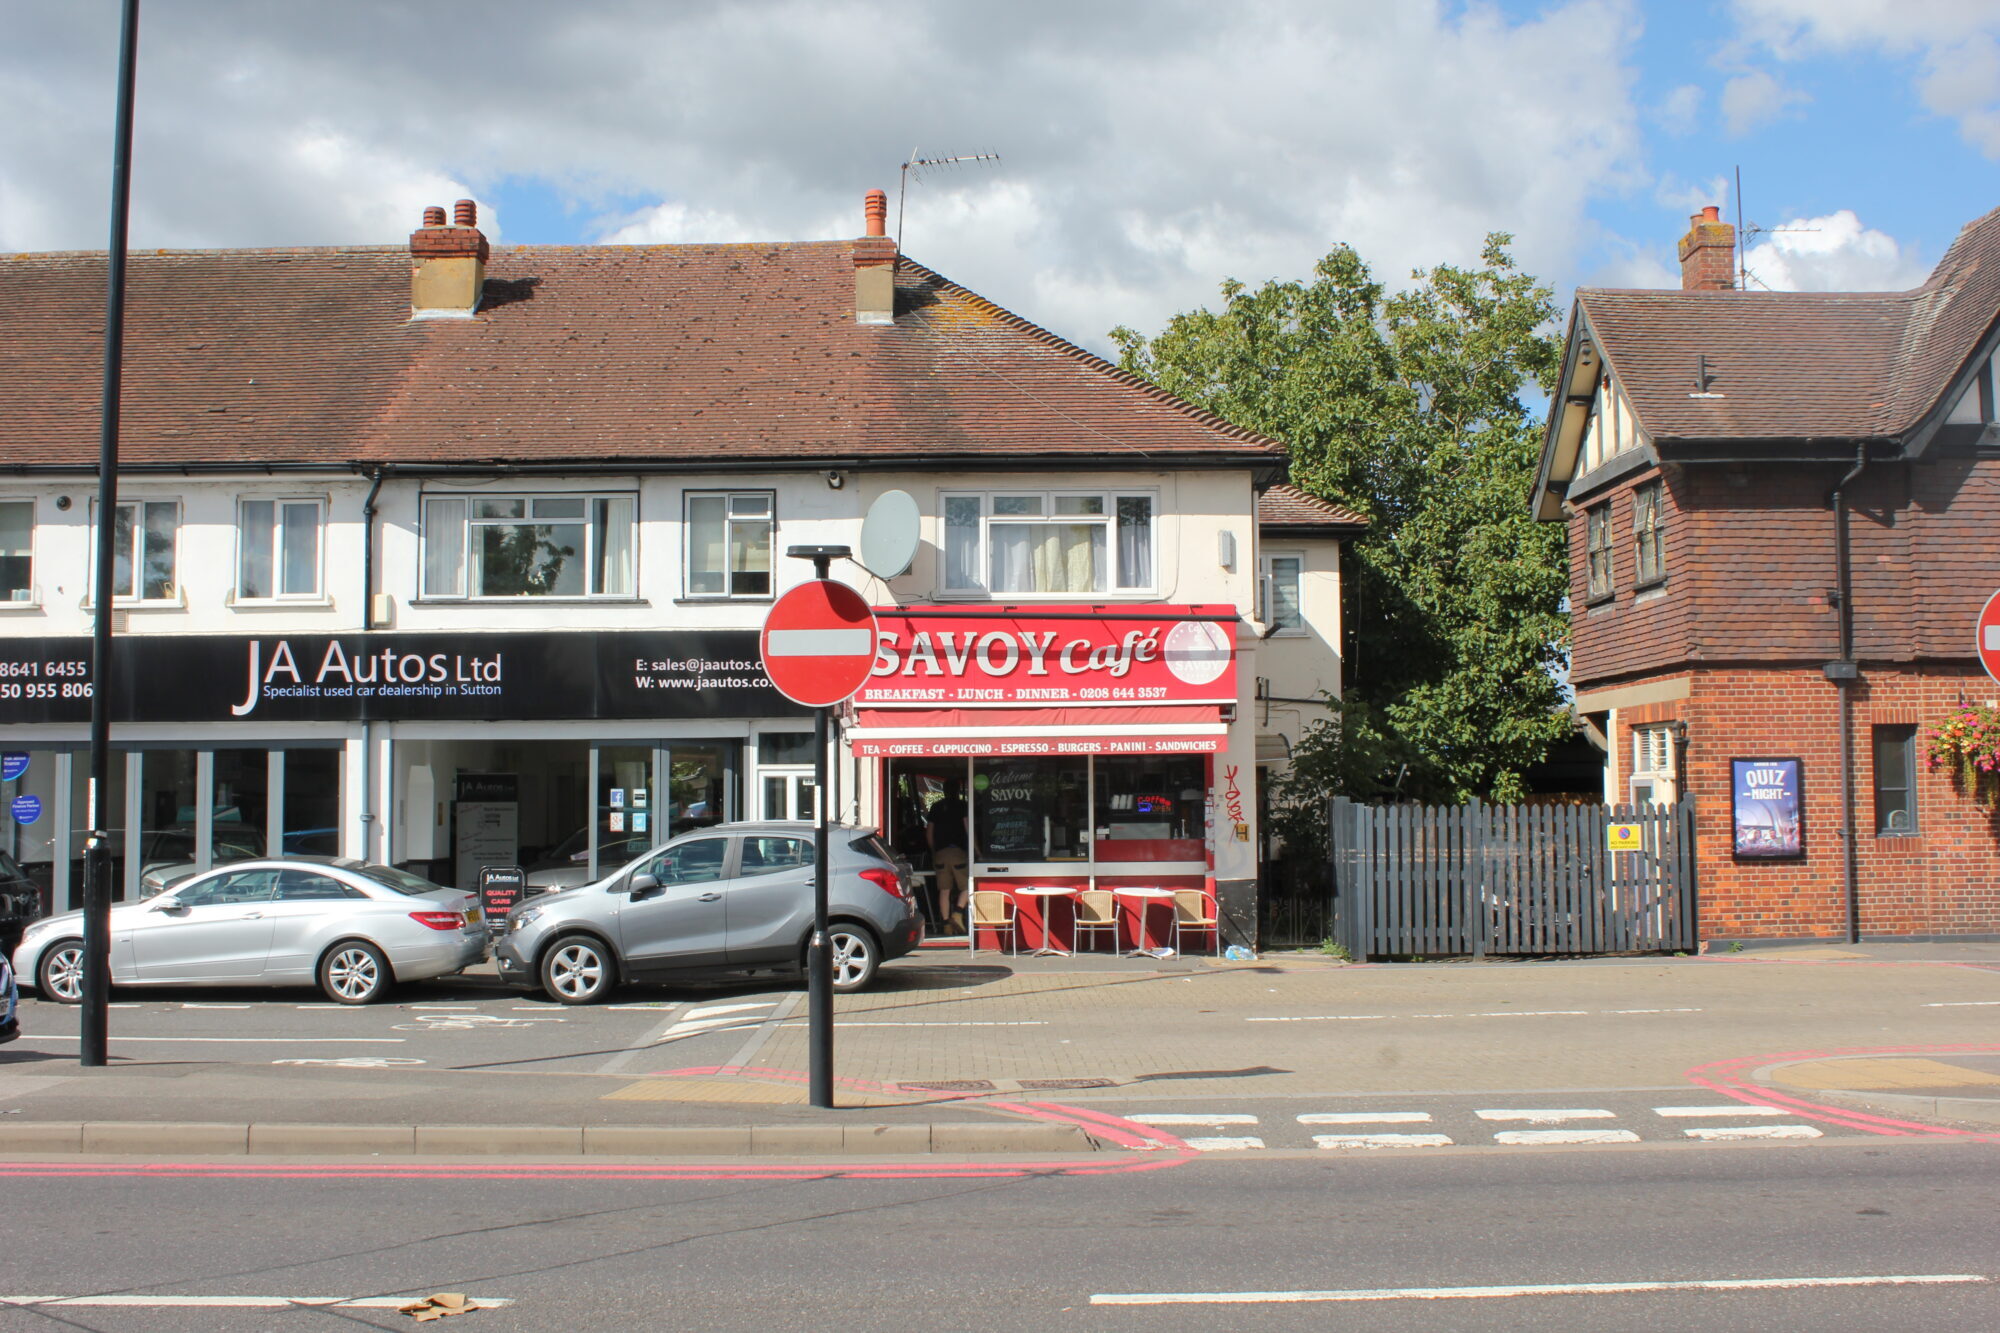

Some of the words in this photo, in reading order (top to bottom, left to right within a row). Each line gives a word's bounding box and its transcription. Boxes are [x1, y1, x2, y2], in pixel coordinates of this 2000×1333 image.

[871, 631, 1057, 677] SAVOY
[1060, 627, 1161, 678] Café
[0, 661, 38, 677] 8641
[45, 661, 87, 677] 6455
[636, 658, 648, 671] E:
[231, 640, 302, 716] JA
[315, 639, 449, 683] Autos
[456, 653, 502, 682] Ltd
[635, 676, 655, 689] W:
[0, 683, 22, 698] 50
[25, 683, 57, 698] 955
[61, 683, 94, 698] 806
[263, 684, 321, 699] Specialist
[323, 684, 353, 697] used
[356, 686, 375, 697] car
[378, 683, 442, 699] dealership
[445, 684, 457, 696] in
[460, 683, 502, 696] Sutton
[864, 688, 945, 700] BREAKFAST
[957, 688, 1004, 699] LUNCH
[1015, 687, 1070, 699] DINNER
[1079, 687, 1110, 699] 0208
[1112, 687, 1135, 698] 644
[1137, 686, 1168, 698] 3537
[862, 744, 880, 755] TEA
[889, 744, 923, 754] COFFEE
[932, 743, 992, 753] CAPPUCCINO
[1001, 742, 1049, 753] ESPRESSO
[1057, 743, 1102, 753] BURGERS
[1110, 741, 1146, 752] PANINI
[1154, 740, 1217, 751] SANDWICHES
[1745, 769, 1786, 788] QUIZ
[990, 788, 1033, 801] SAVOY
[1751, 788, 1784, 800] NIGHT
[486, 889, 517, 897] QUALITY
